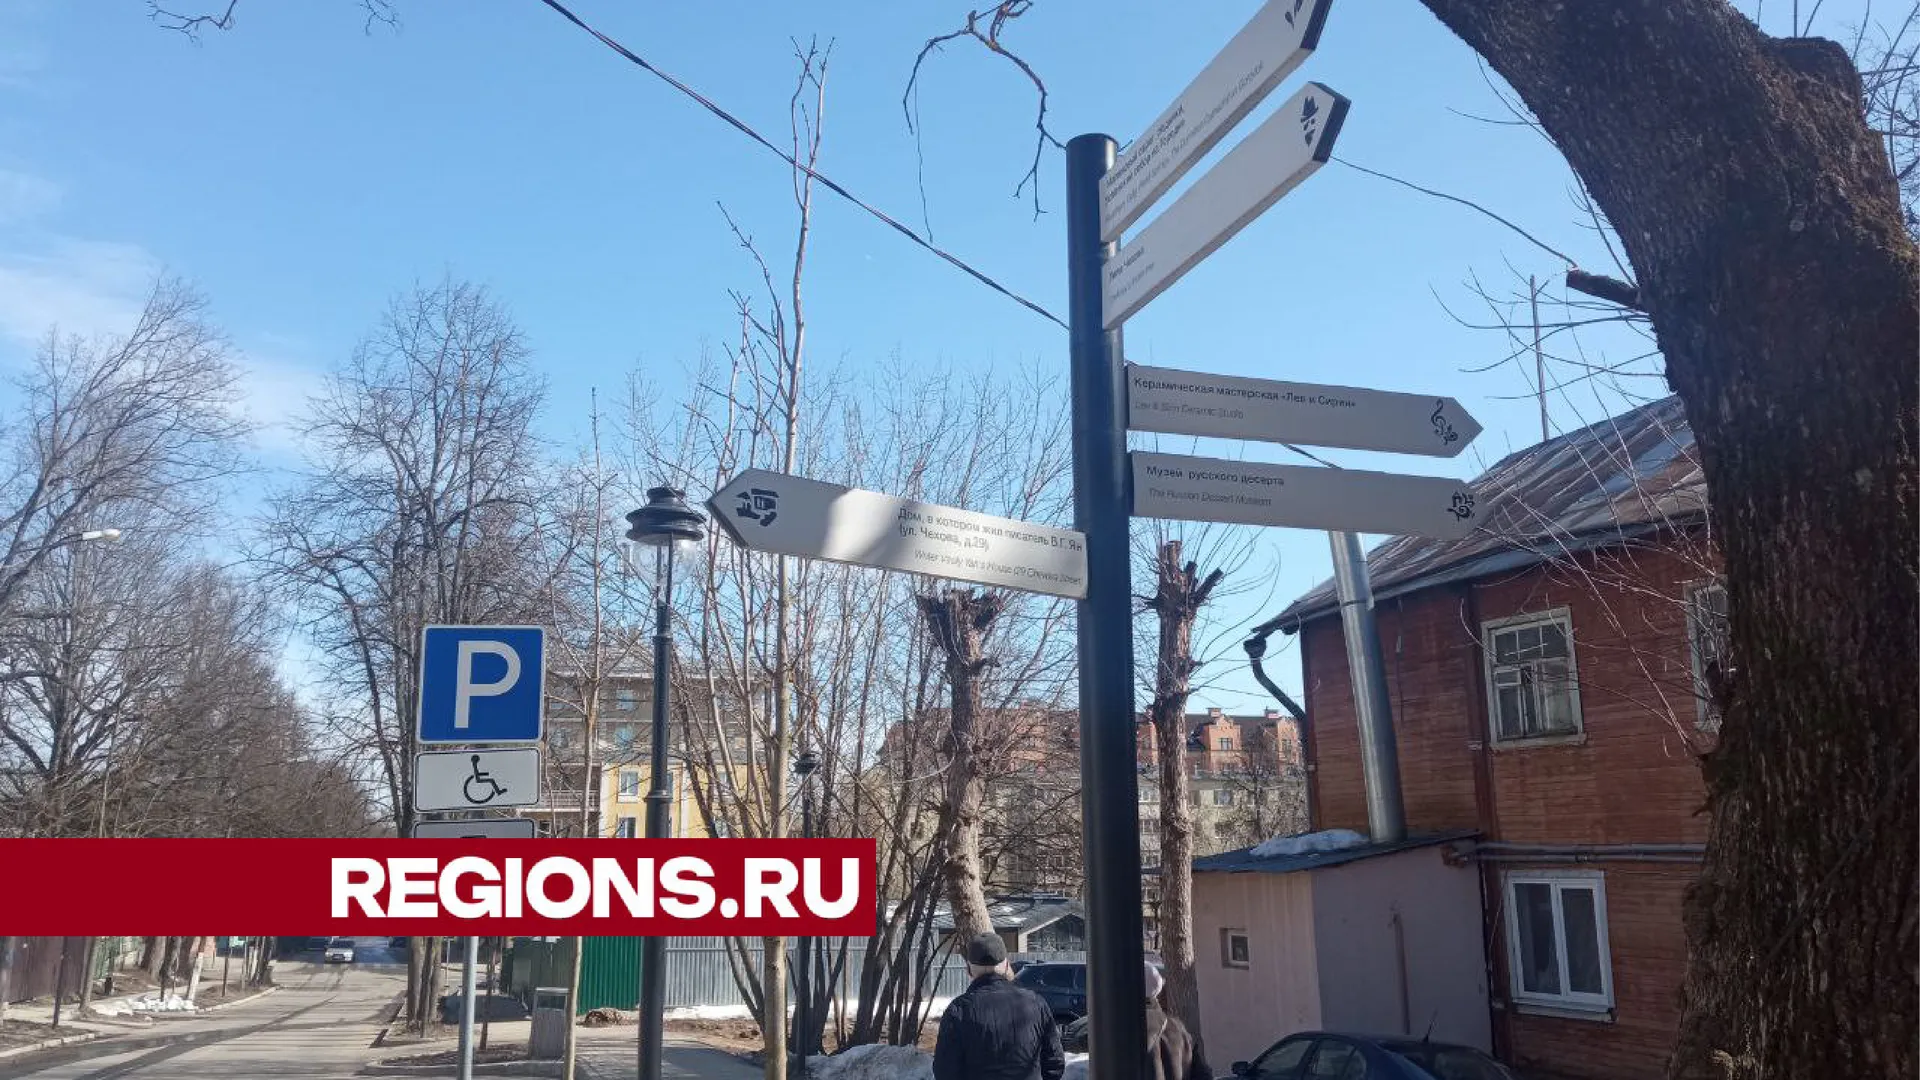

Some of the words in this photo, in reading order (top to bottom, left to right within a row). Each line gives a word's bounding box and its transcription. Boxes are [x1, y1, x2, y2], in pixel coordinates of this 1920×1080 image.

[1134, 377, 1215, 395] Керамическая
[1217, 387, 1279, 401] мастерская
[1146, 465, 1183, 478] Музей
[1188, 470, 1238, 483] русского
[1241, 474, 1285, 486] десерта
[898, 507, 925, 524] Дом,
[936, 516, 980, 531] котором
[982, 525, 1003, 535] жил
[1004, 530, 1049, 546] писатель
[920, 526, 962, 546] Чехова,
[454, 640, 521, 729] P
